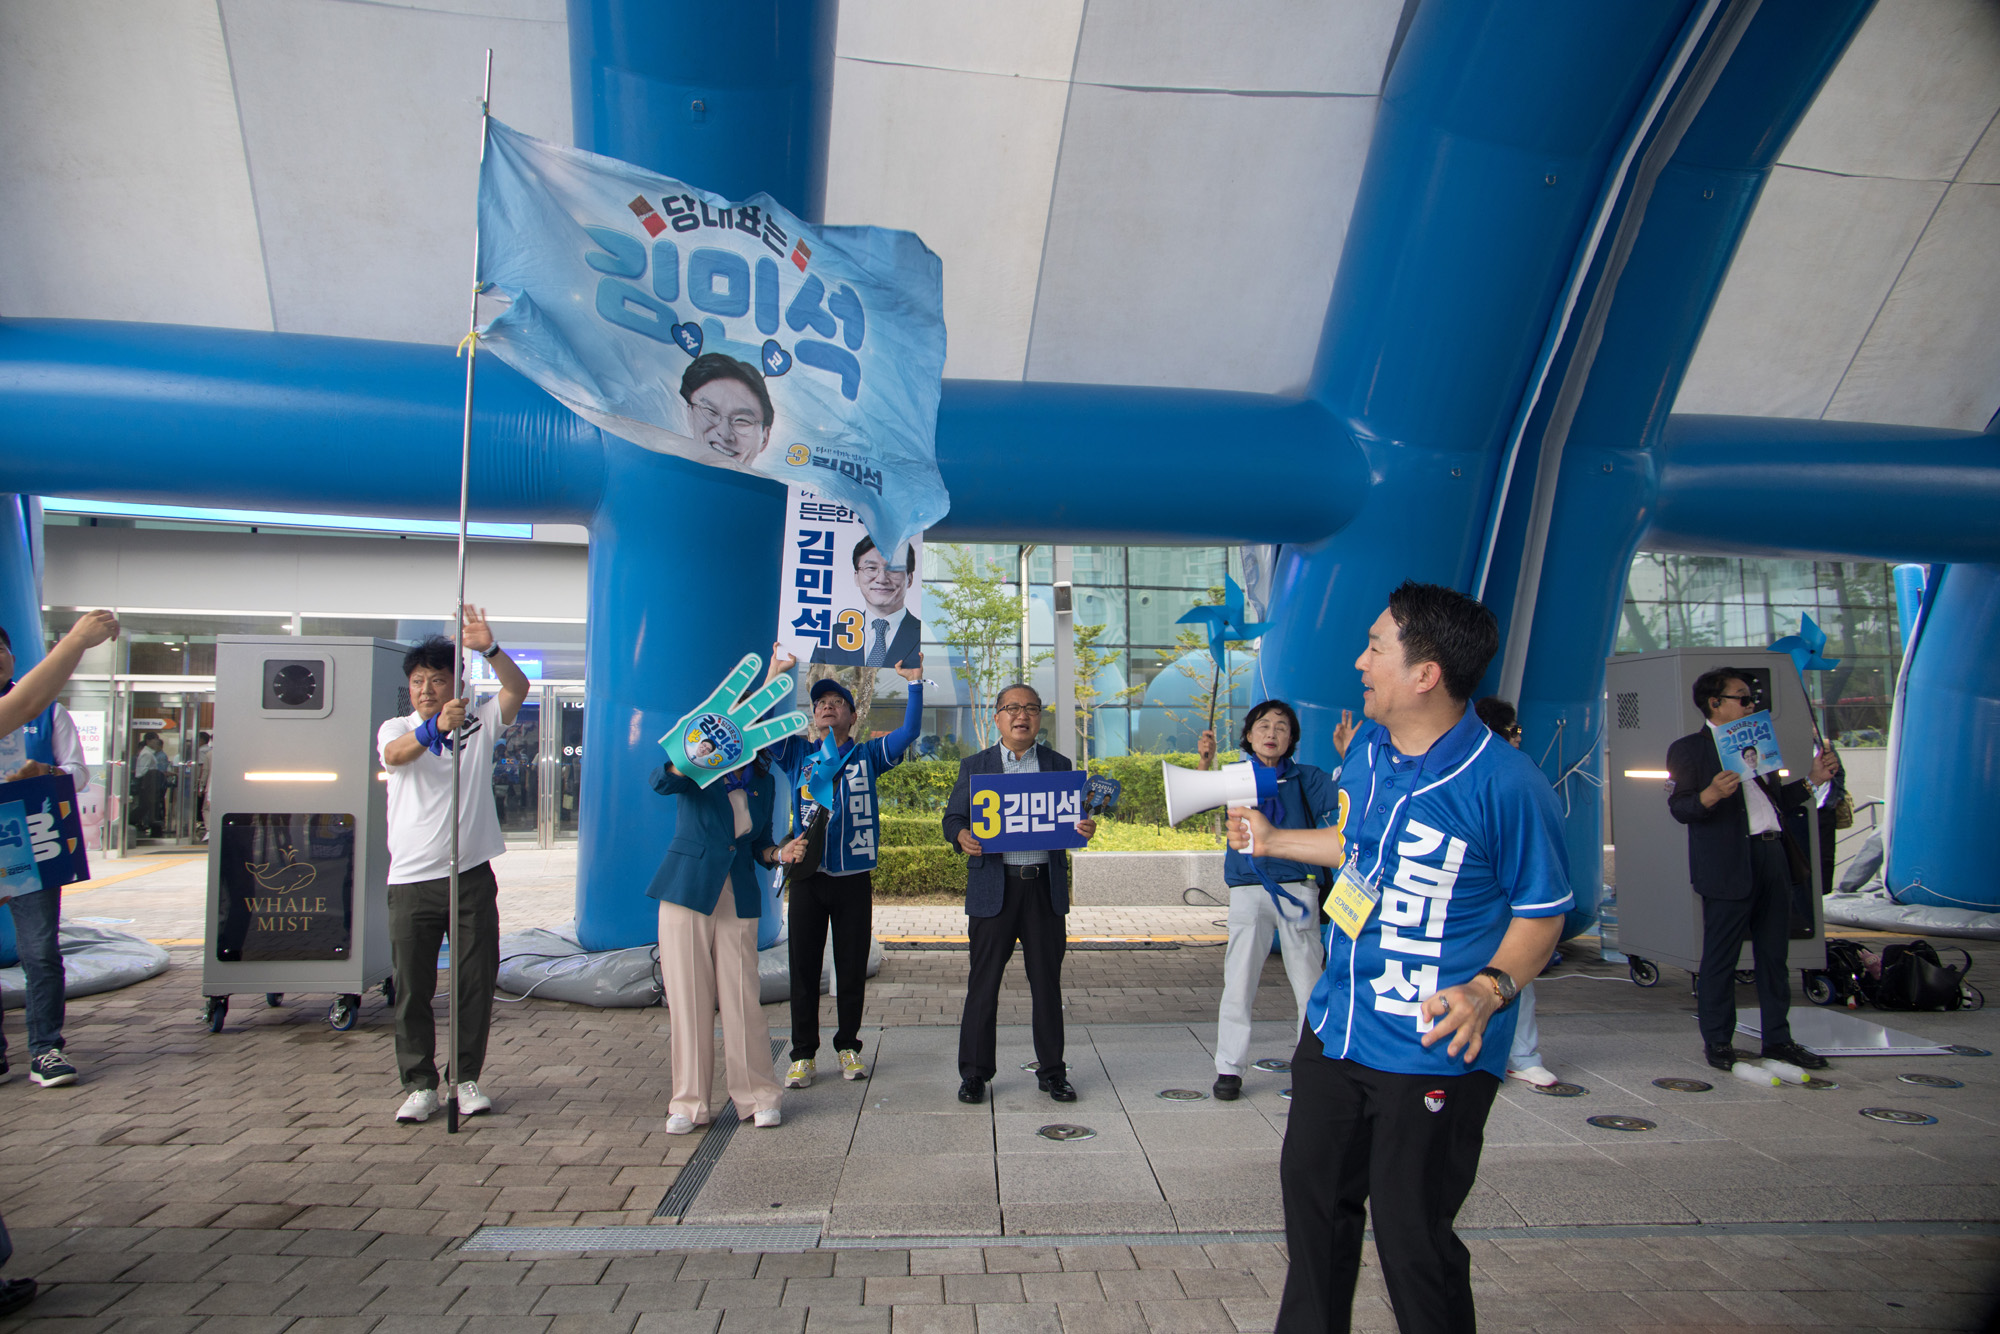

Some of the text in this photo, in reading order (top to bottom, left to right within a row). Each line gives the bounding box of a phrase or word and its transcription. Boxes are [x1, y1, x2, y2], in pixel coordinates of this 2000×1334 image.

[662, 194, 787, 258] 당대표는
[584, 223, 866, 402] 김민석
[786, 443, 811, 467] 3
[791, 529, 835, 649] 김민석
[837, 608, 866, 652] 3
[699, 714, 742, 760] 김민석
[707, 753, 723, 767] 3
[1720, 722, 1772, 755] 김민석
[845, 759, 876, 860] 김민석
[972, 789, 1081, 839] 3 김민석
[244, 897, 327, 913] WHALE
[257, 916, 313, 931] MIST
[1369, 818, 1468, 1033] 김민석
